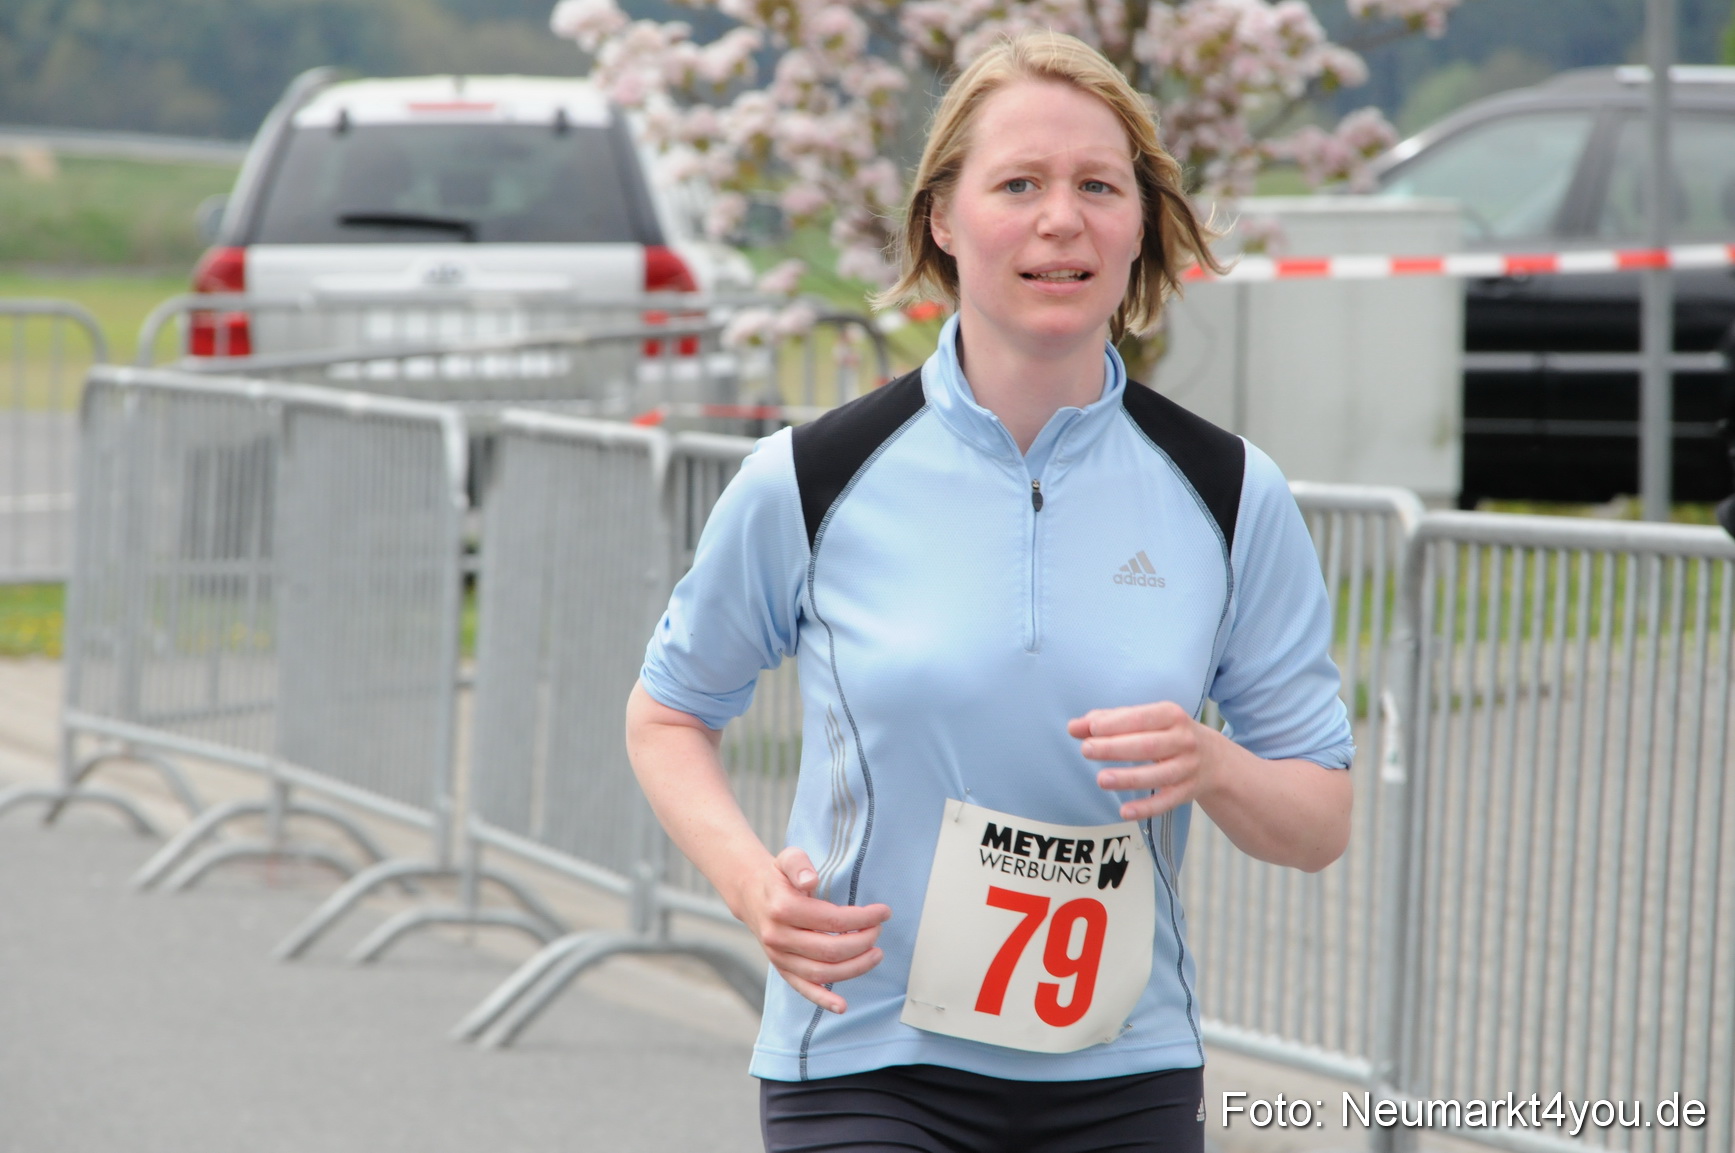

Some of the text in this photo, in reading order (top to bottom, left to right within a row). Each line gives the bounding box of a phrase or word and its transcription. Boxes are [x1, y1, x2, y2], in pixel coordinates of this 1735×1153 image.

[1113, 572, 1166, 588] adidas
[981, 822, 1094, 864] MEYER
[979, 848, 1092, 884] WERBUNG
[974, 885, 1108, 1027] 79
